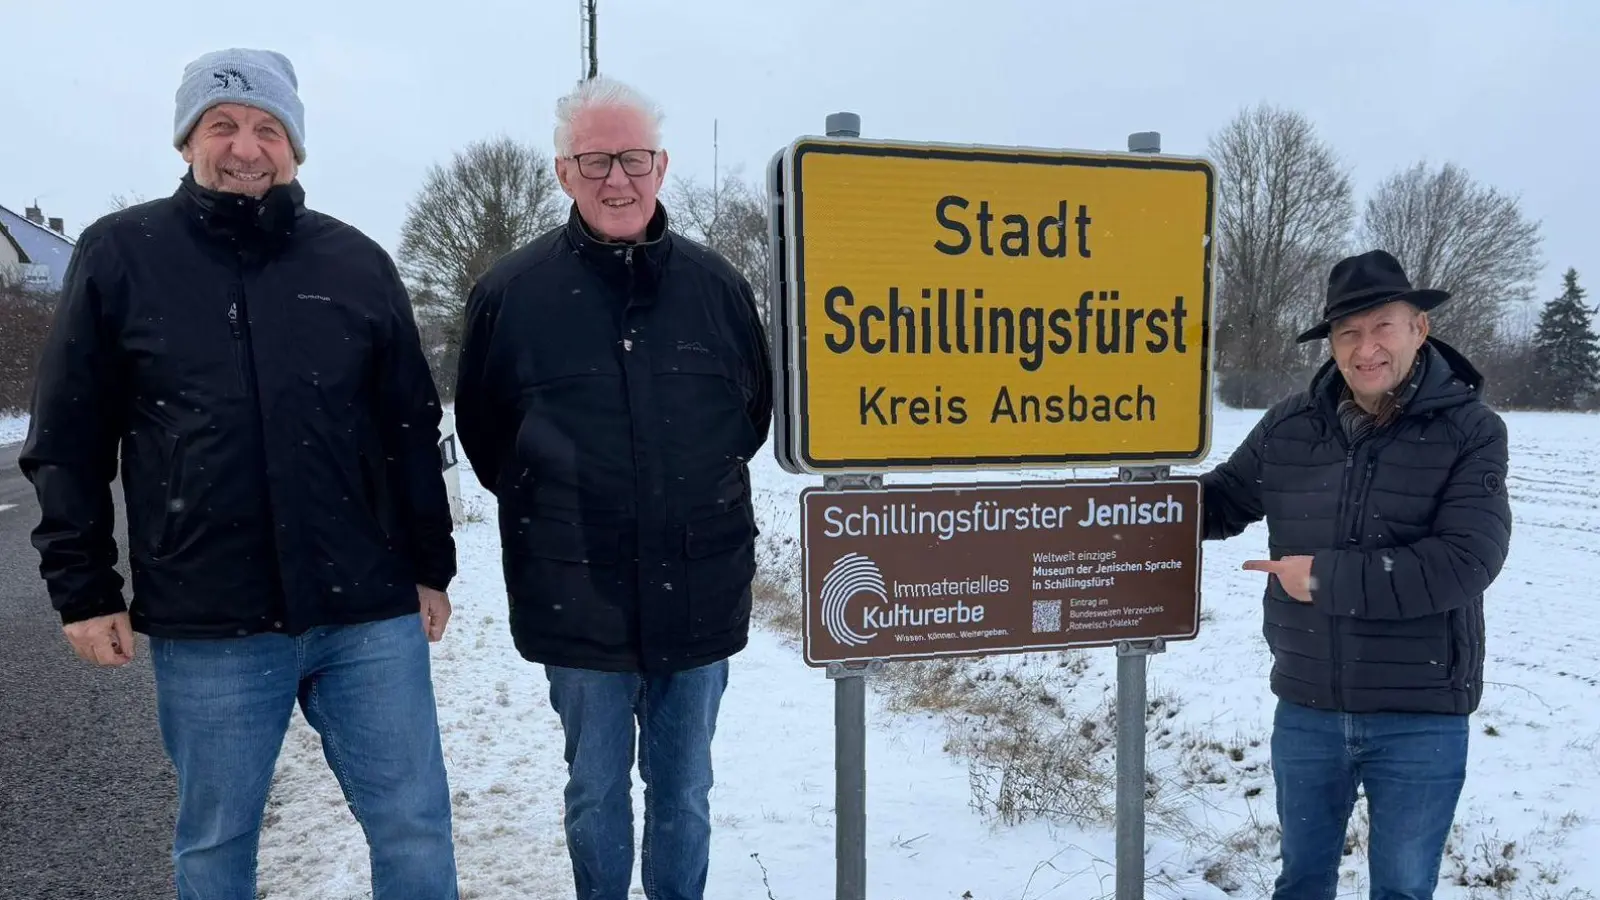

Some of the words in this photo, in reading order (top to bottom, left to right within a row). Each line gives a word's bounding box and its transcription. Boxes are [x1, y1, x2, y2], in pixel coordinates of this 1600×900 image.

[933, 195, 1092, 259] Stadt
[824, 285, 1188, 372] Schillingsfürst
[859, 385, 968, 425] Kreis
[990, 384, 1155, 425] Ansbach
[823, 501, 1072, 541] Schillingsfürster
[1077, 494, 1184, 528] Jenisch
[1032, 551, 1076, 563] Weltweit
[1078, 550, 1117, 563] einziges
[1032, 565, 1074, 577] Museum
[1076, 563, 1093, 574] der
[1095, 561, 1142, 573] Jenischen
[1144, 559, 1182, 573] Sprache
[893, 575, 1010, 598] Immaterielles
[1032, 580, 1042, 590] in
[1044, 576, 1115, 590] Schillingsfürst
[1070, 598, 1097, 608] Eintrag
[1098, 597, 1109, 606] im
[1123, 604, 1164, 615] Verzeichnis
[862, 600, 985, 629] Kulturerbe
[893, 633, 926, 643] Wissen.
